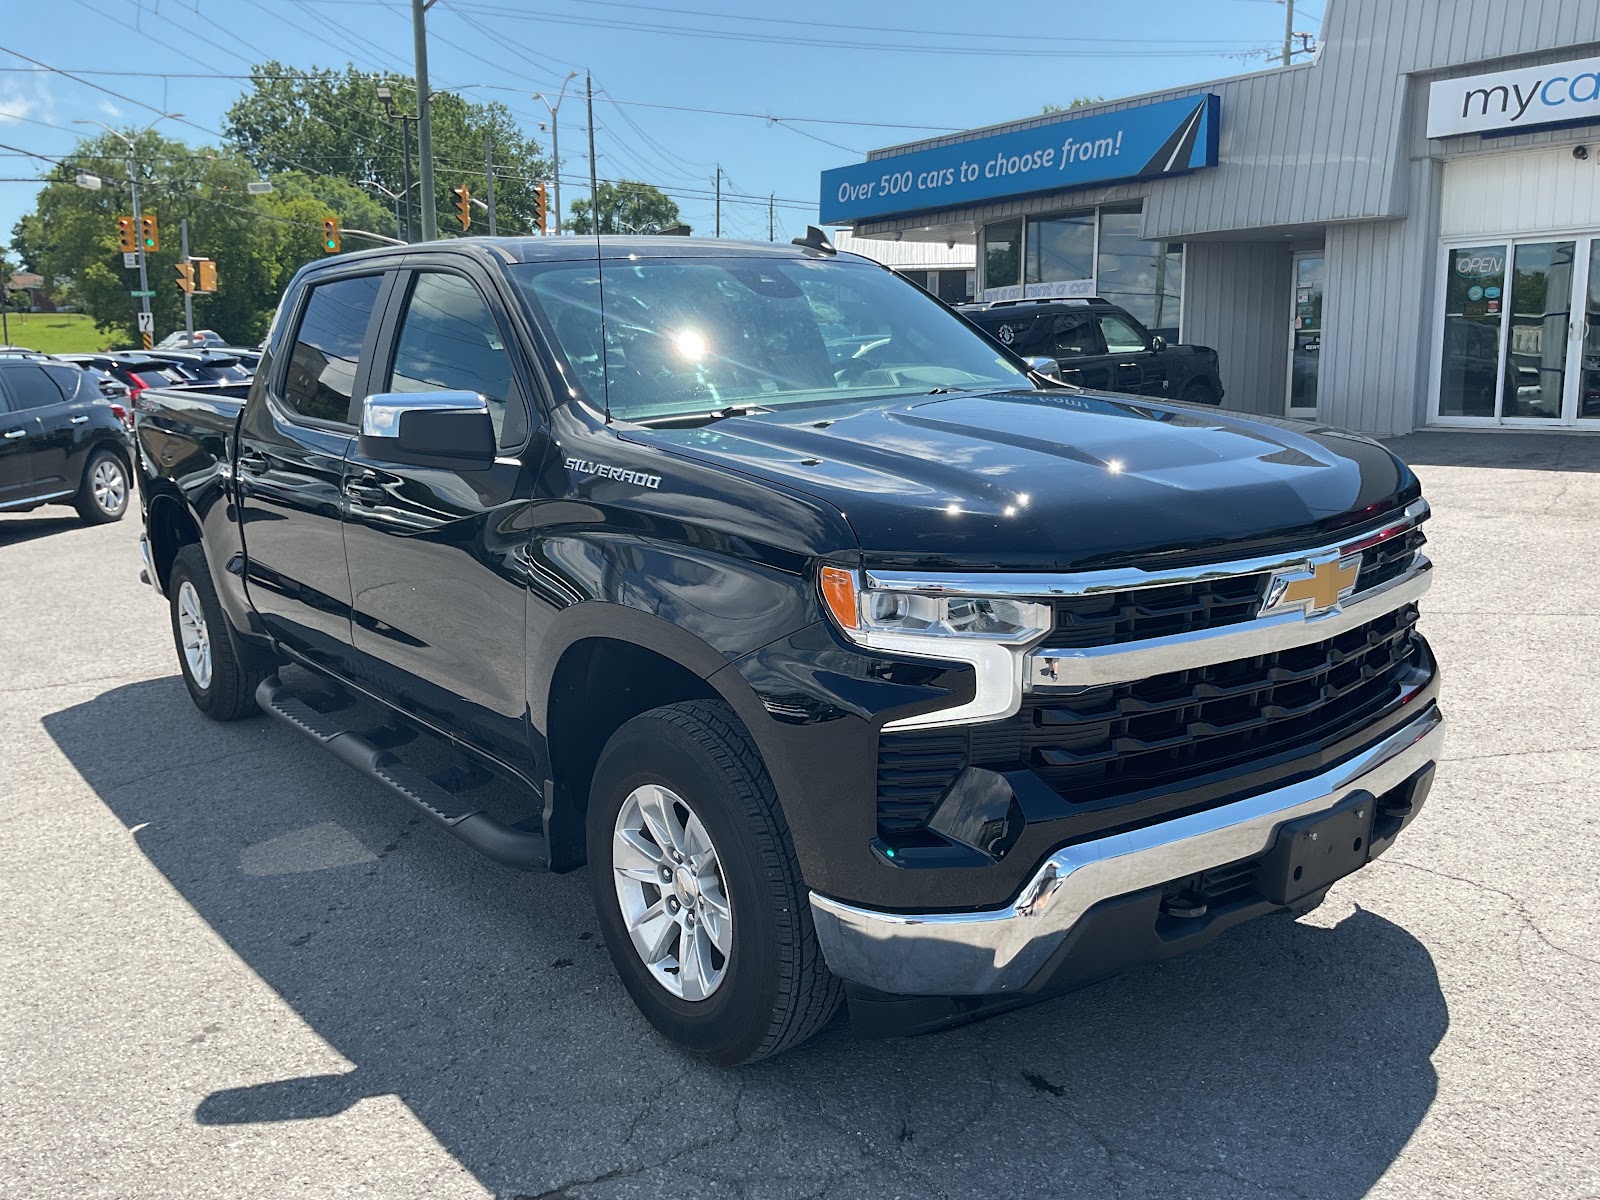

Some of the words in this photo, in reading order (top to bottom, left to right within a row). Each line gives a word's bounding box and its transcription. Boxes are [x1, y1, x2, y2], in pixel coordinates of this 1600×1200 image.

[838, 181, 875, 203] Over
[878, 171, 913, 198] 500
[917, 167, 954, 189] cars
[960, 160, 979, 182] to
[984, 152, 1054, 179] choose
[1059, 130, 1123, 171] from!
[1458, 257, 1503, 273] OPEN
[1025, 284, 1053, 298] rent
[1056, 284, 1066, 296] a
[1069, 281, 1093, 295] car
[563, 457, 662, 490] SILVERADO
